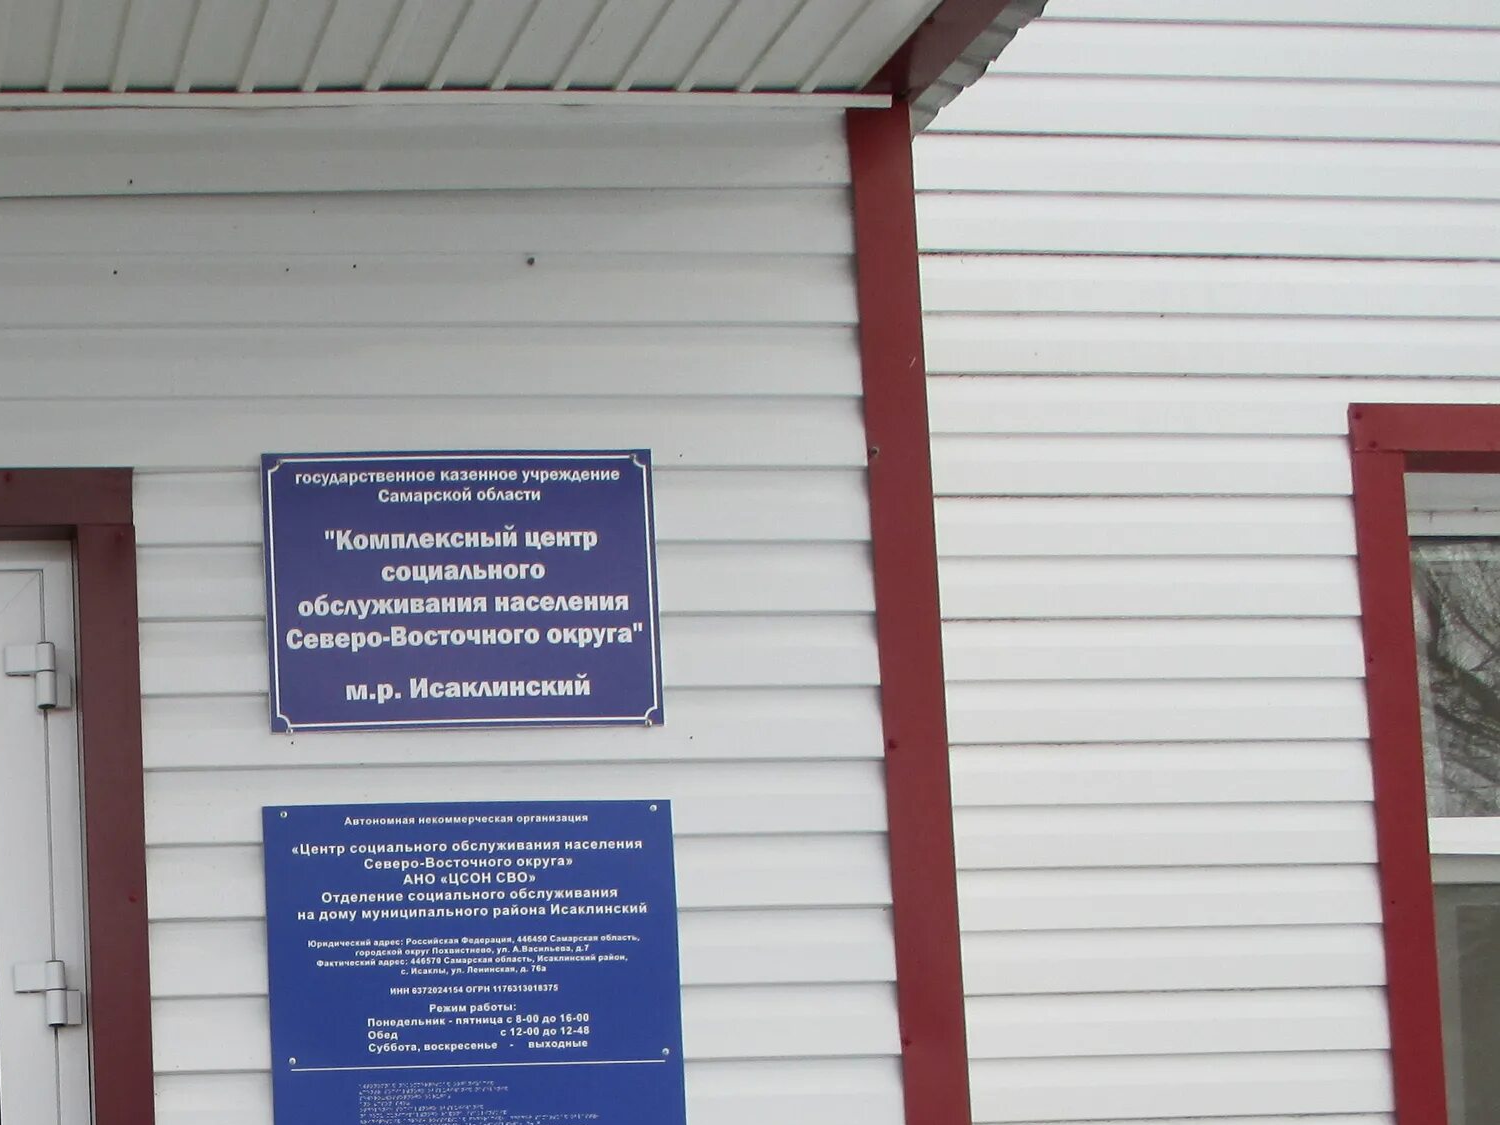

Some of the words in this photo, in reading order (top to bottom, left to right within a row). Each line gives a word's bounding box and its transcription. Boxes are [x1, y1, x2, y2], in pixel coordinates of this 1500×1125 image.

[295, 470, 436, 487] государственное
[440, 469, 518, 481] казенное
[521, 469, 620, 484] учреждение
[378, 486, 472, 505] Самарской
[476, 486, 541, 501] области
[324, 524, 518, 551] "Комплексный
[524, 530, 598, 551] центр
[381, 562, 546, 584] социального
[297, 593, 487, 620] обслуживания
[494, 594, 629, 612] населения
[286, 625, 540, 653] Северо-Восточного
[546, 621, 643, 649] округа"
[345, 683, 402, 705] м.р.
[409, 672, 591, 699] Исаклинский
[344, 816, 415, 826] Автономная
[418, 815, 514, 825] некоммерческая
[516, 814, 589, 825] организация
[291, 843, 346, 857] «Центр
[349, 843, 448, 855] социального
[451, 839, 560, 854] обслуживания
[564, 840, 643, 850] населения
[363, 856, 513, 872] Северо-Восточного
[516, 857, 573, 870] округа»
[403, 873, 436, 885] АНО
[440, 871, 492, 886] «ЦСОН
[495, 871, 536, 884] СВО»
[321, 891, 404, 905] Отделение
[407, 890, 506, 903] социального
[509, 887, 618, 902] обслуживания
[297, 911, 315, 921] на
[318, 910, 357, 922] дому
[361, 907, 489, 922] муниципального
[492, 904, 546, 919] района
[550, 902, 648, 915] Исаклинский
[307, 938, 372, 949] Юридический
[373, 939, 404, 948] адрес:
[405, 937, 459, 946] Российская
[516, 934, 548, 943] 446450
[549, 934, 599, 944] Самарская
[316, 958, 376, 967] Фактический
[410, 956, 442, 965] 446570
[443, 956, 493, 966] Самарская
[536, 953, 597, 963] Исаклинский
[355, 948, 403, 958] городской
[404, 948, 431, 957] округ
[496, 947, 511, 955] ул.
[410, 967, 449, 975] Исаклы,
[450, 967, 465, 976] ул.
[519, 966, 529, 974] д.
[531, 964, 547, 972] 76а
[389, 987, 410, 995] ИНН
[465, 985, 491, 994] ОГРН
[429, 1003, 467, 1013] Режим
[469, 1002, 517, 1014] работы:
[367, 1017, 446, 1028] Понедельник
[455, 1016, 503, 1026] пятница
[515, 1014, 540, 1024] 8-00
[541, 1015, 557, 1024] до
[559, 1012, 590, 1023] 16-00
[367, 1030, 399, 1041] Обед
[509, 1026, 540, 1036] 12-00
[542, 1028, 557, 1037] до
[560, 1025, 590, 1036] 12-48
[368, 1042, 421, 1055] Суббота,
[423, 1042, 498, 1053] воскресенье
[528, 1040, 588, 1049] выходные
